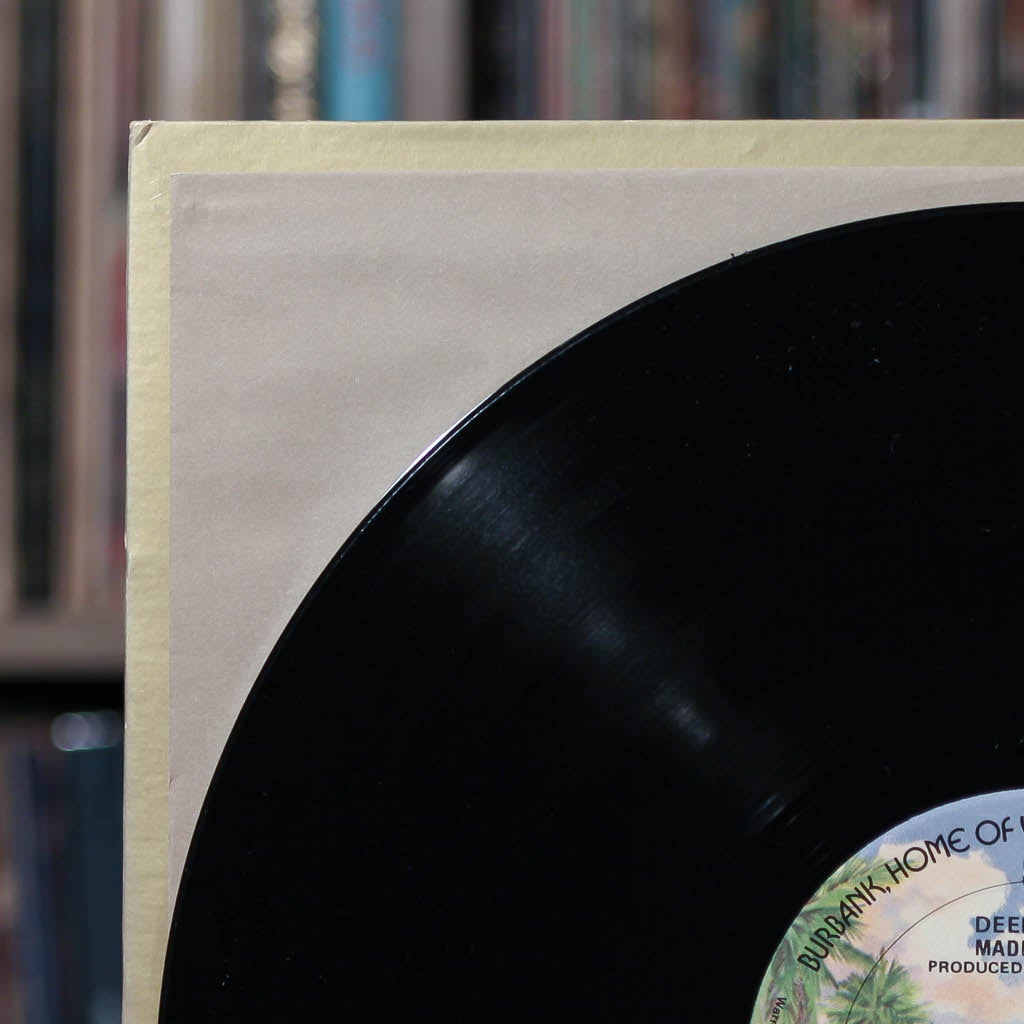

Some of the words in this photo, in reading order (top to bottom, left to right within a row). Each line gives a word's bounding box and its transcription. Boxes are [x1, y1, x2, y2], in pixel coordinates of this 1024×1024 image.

[797, 875, 892, 973] BURBANK,
[885, 827, 971, 885] HOME
[975, 817, 1014, 846] OF
[928, 960, 1023, 974] PRODUCED
